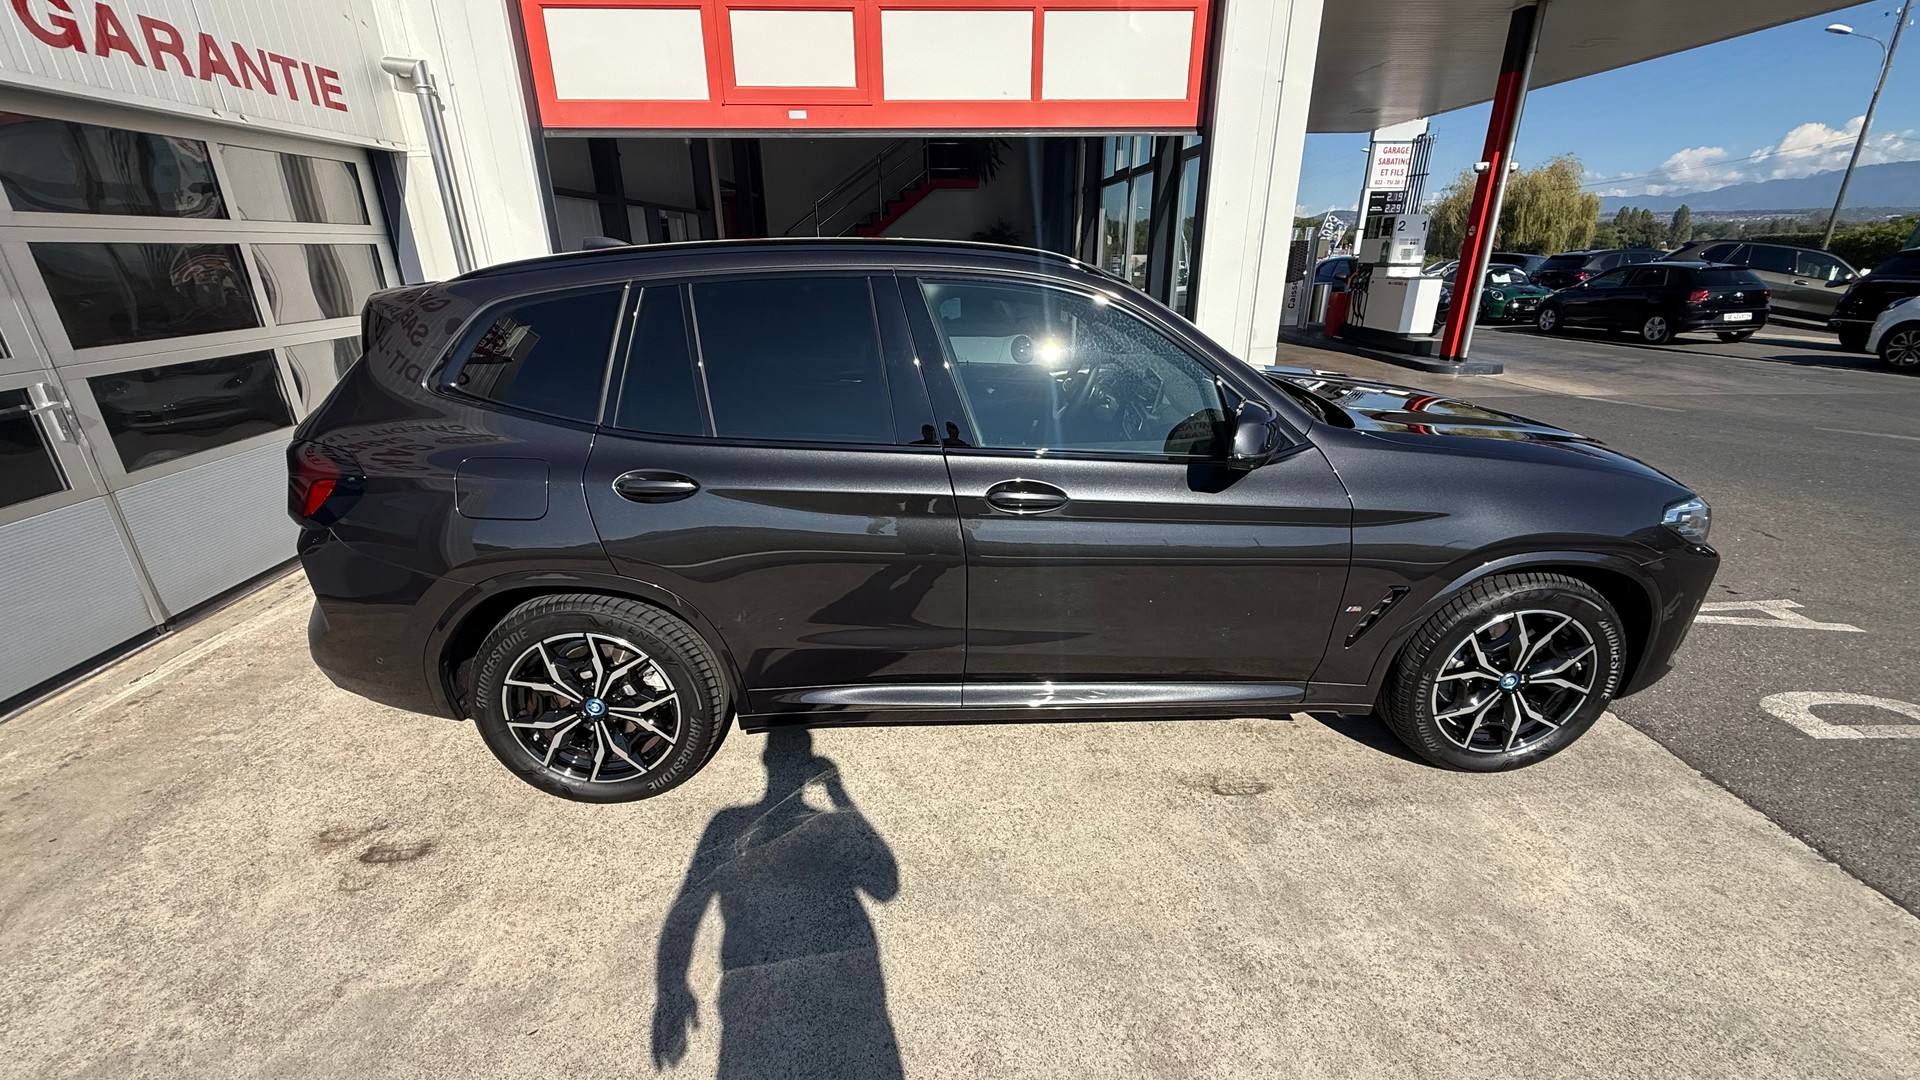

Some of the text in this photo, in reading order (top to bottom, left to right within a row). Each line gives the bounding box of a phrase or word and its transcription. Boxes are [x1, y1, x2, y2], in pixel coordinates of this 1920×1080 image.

[9, 0, 348, 112] GARANTIE
[1378, 157, 1410, 165] SABATINO
[1381, 168, 1405, 176] ET FILS
[1383, 146, 1410, 154] GARAGE
[1398, 220, 1427, 231] 2 1
[476, 628, 529, 709] BRIDGESTONE
[1597, 617, 1621, 700] BRIDGESTONE
[1414, 671, 1442, 753] BRIDGESTONE
[647, 717, 702, 792] BRIDGESTONE
